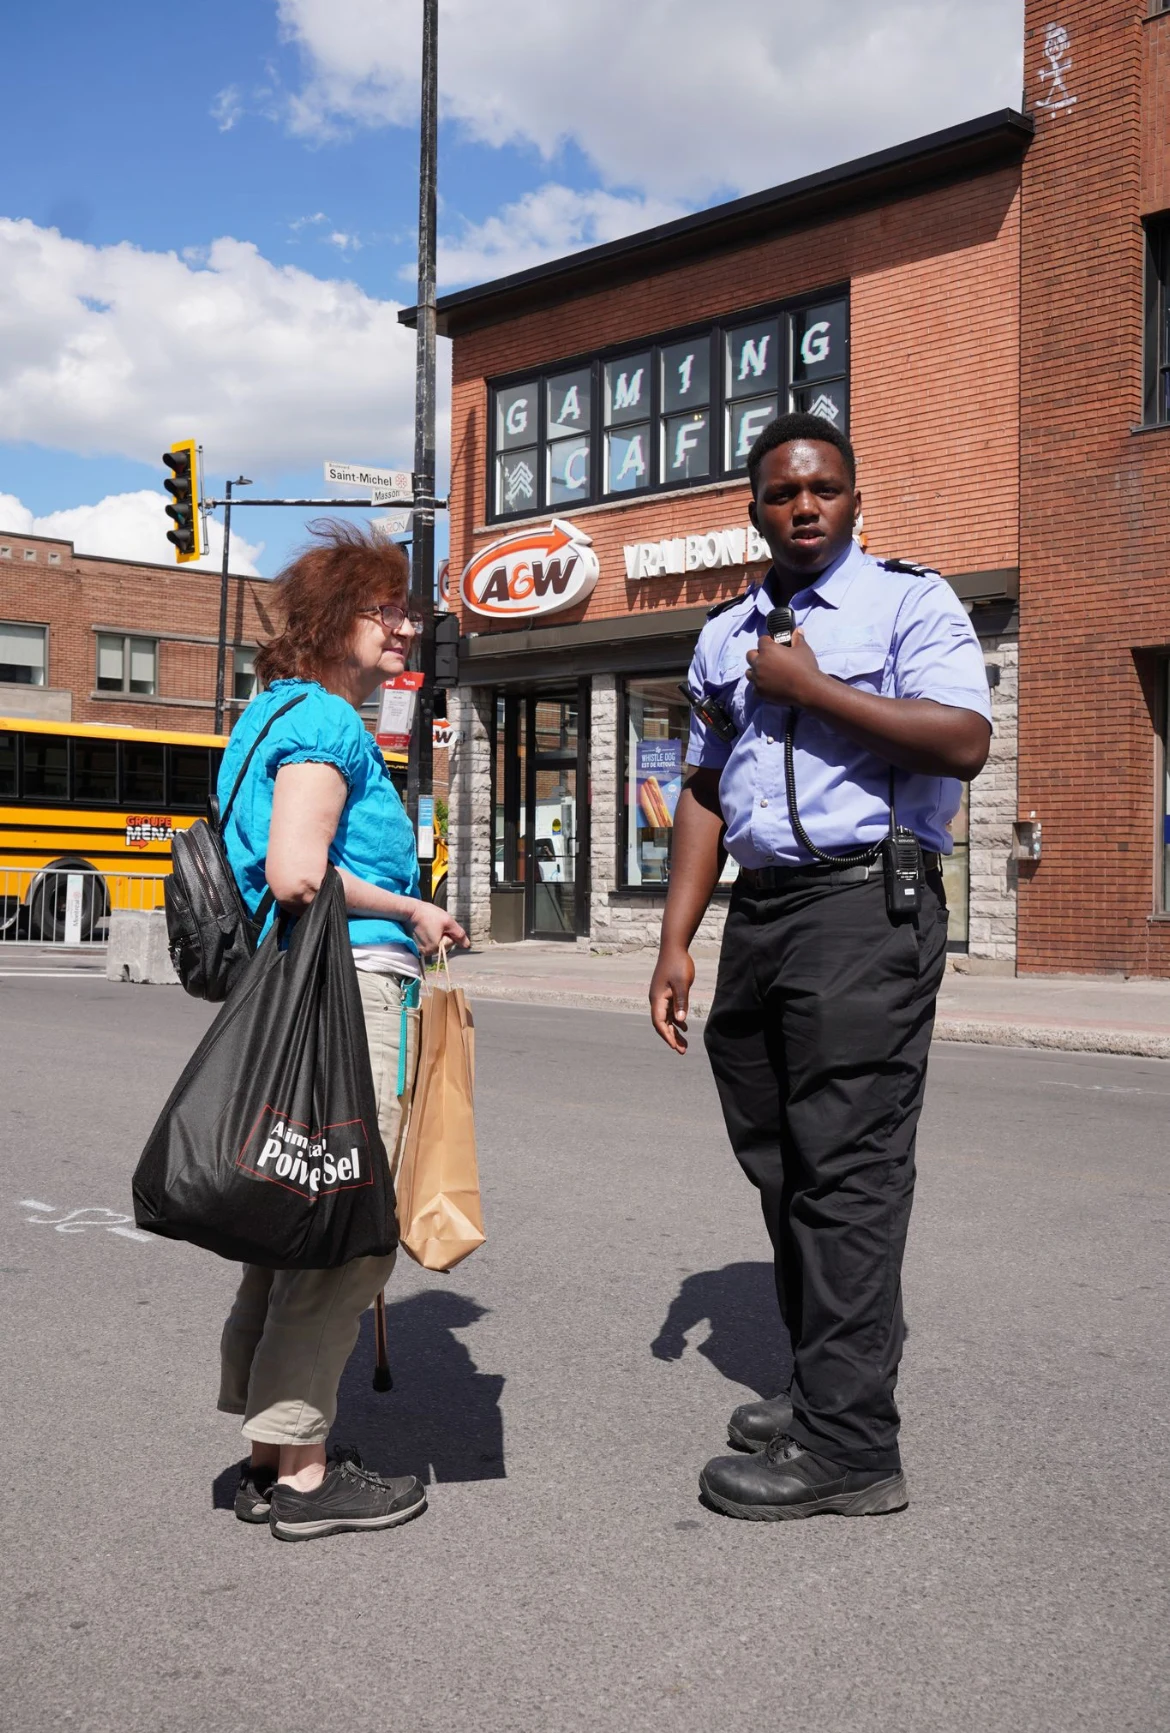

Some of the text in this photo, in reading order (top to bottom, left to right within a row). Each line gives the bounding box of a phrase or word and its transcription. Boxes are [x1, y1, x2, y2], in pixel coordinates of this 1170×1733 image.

[329, 468, 392, 486] Saint-Michel
[374, 490, 400, 501] Masson
[623, 538, 686, 580] VRAI
[686, 528, 747, 571] BON
[478, 554, 579, 605] A&W
[641, 752, 676, 762] WHISTLE DOG
[126, 815, 172, 827] GROUPE
[323, 1148, 360, 1185] Sel
